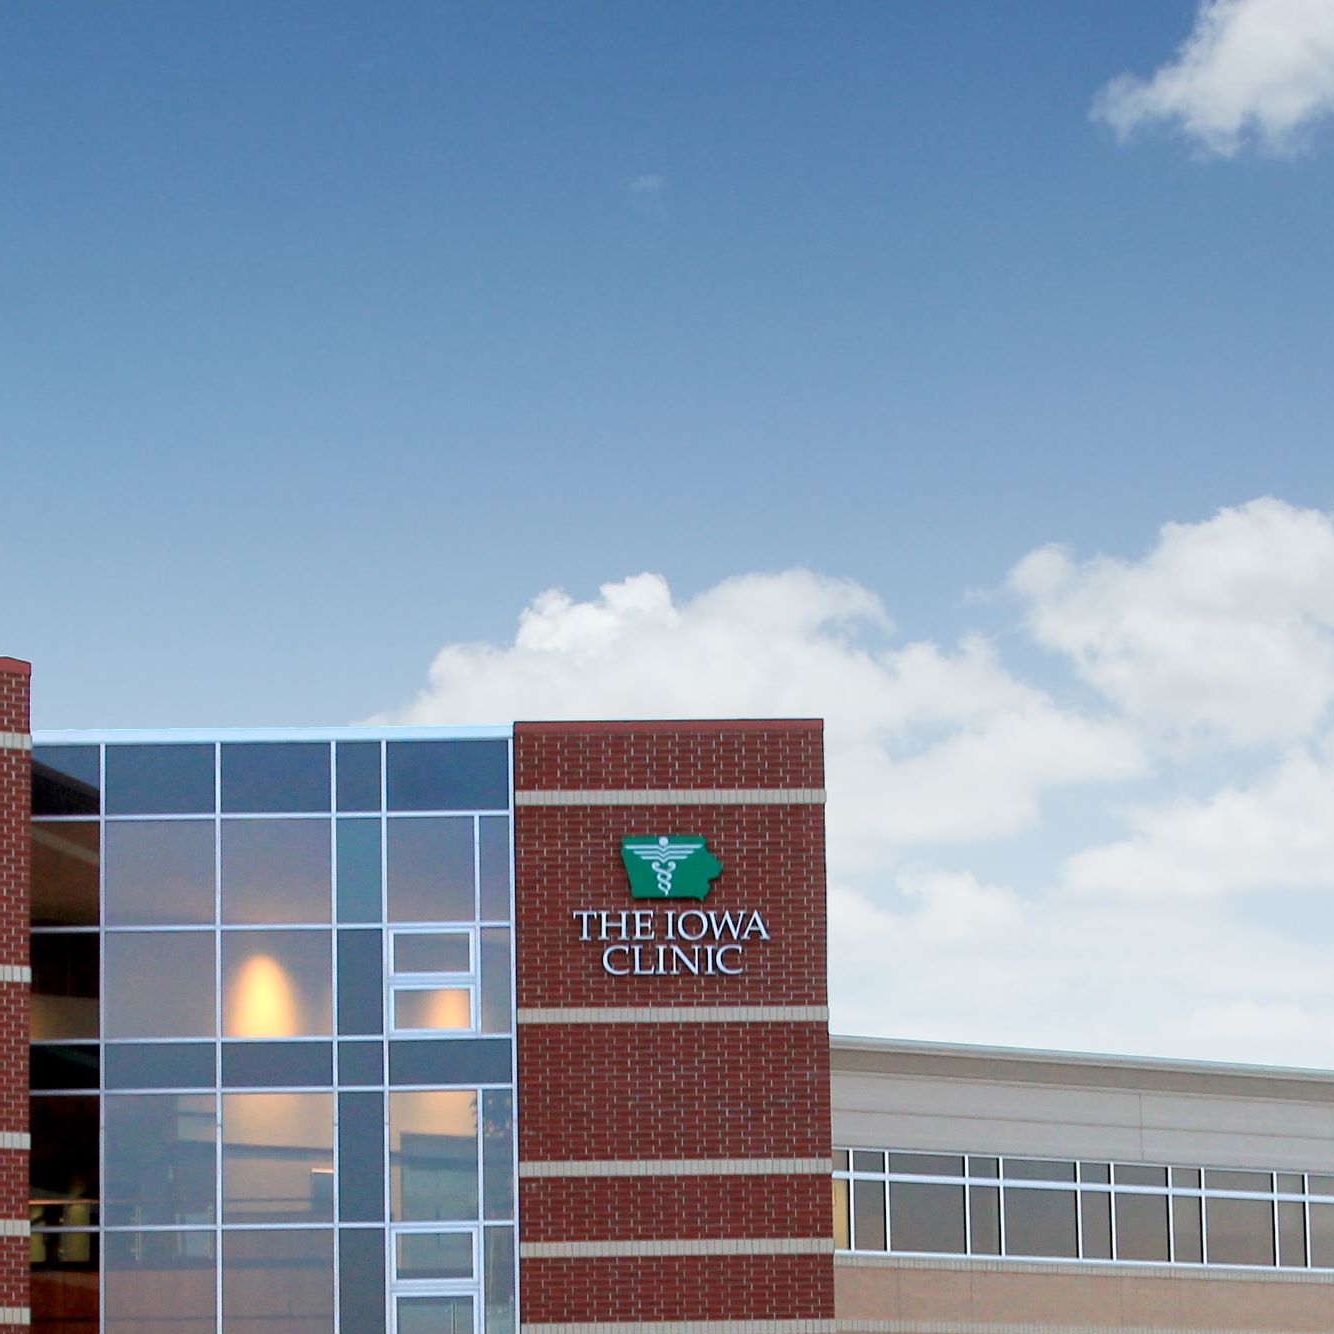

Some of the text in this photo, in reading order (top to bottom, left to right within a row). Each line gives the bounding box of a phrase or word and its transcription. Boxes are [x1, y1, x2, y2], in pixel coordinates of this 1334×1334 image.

[572, 909, 771, 941] THE IOWA
[602, 944, 744, 976] CLINIC
